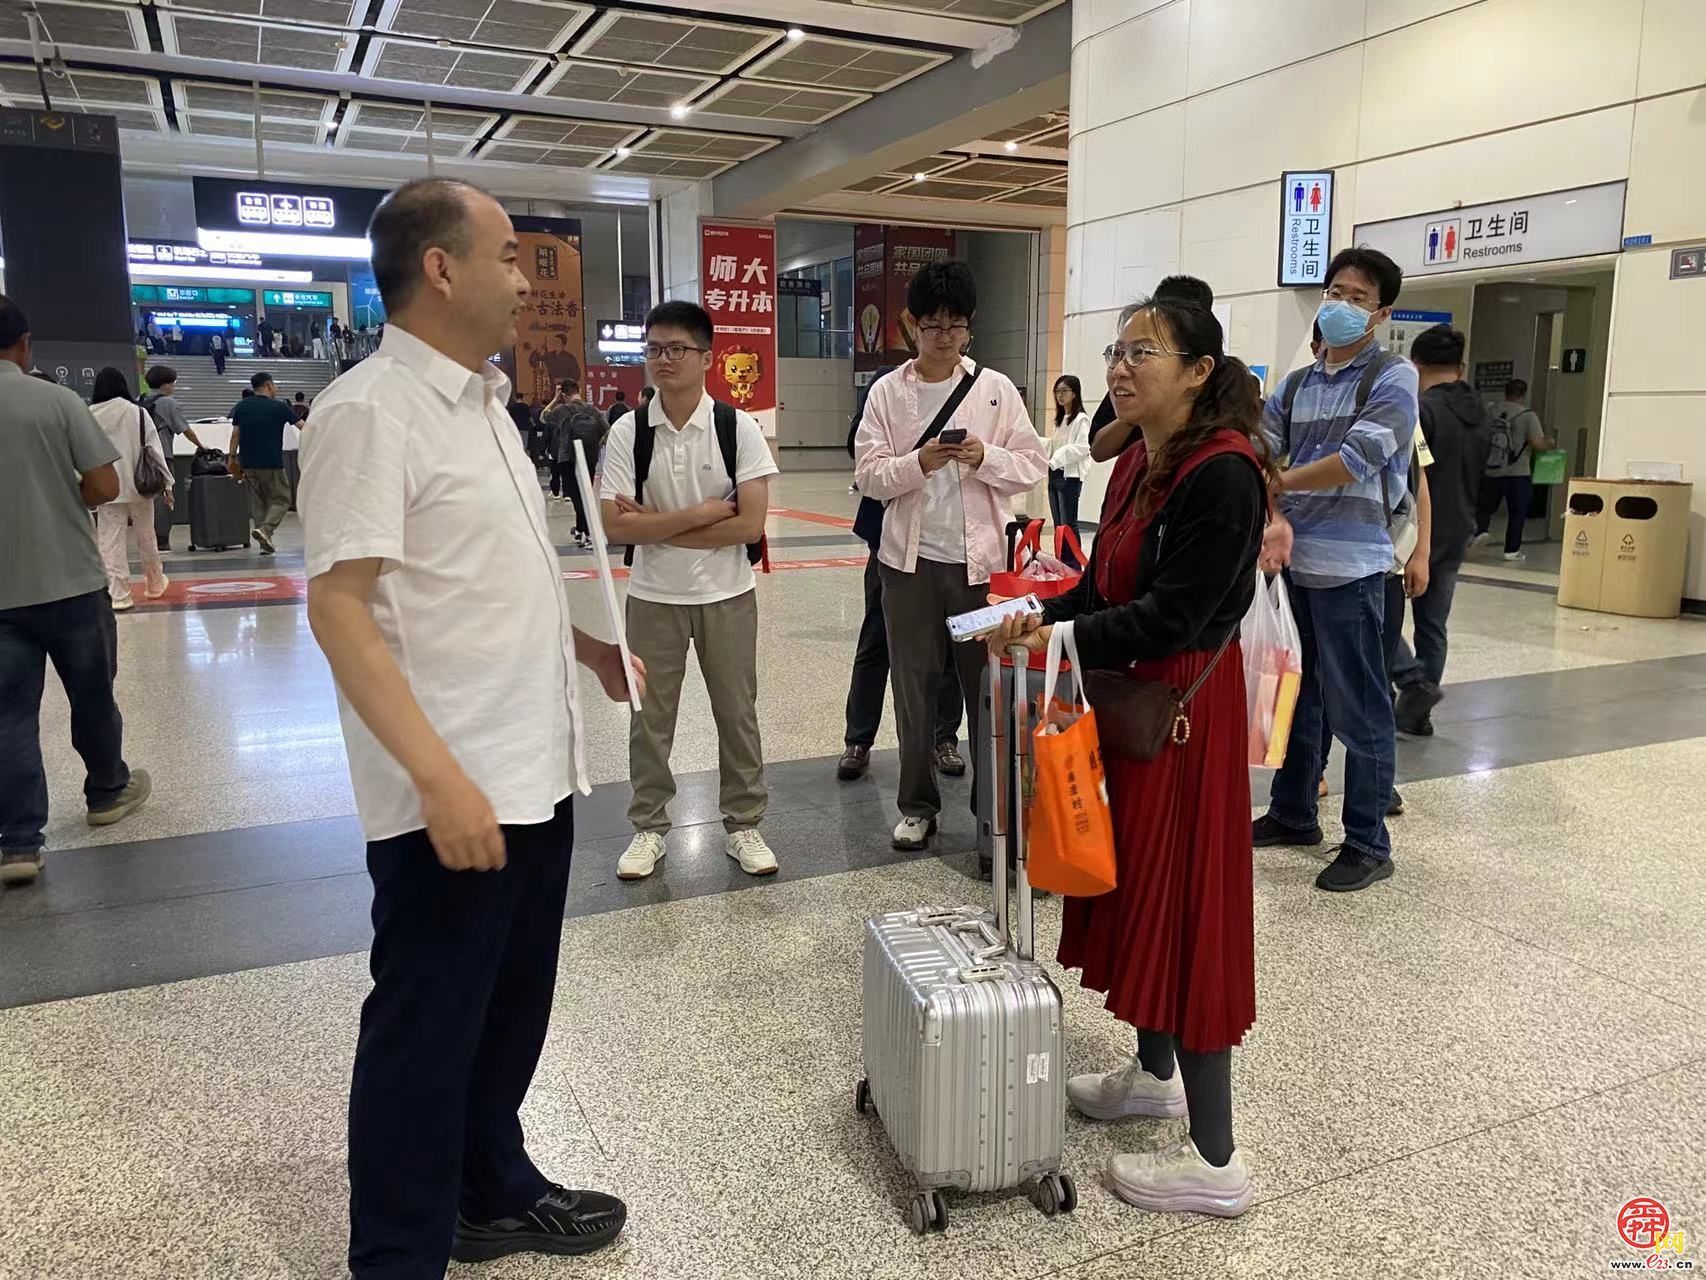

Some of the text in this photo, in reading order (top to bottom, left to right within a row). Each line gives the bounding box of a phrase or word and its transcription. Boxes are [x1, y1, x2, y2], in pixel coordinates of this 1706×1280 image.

[1463, 210, 1530, 241] 卫生间
[1289, 218, 1301, 275] Restrooms
[1301, 218, 1321, 279] 卫生间
[1462, 242, 1523, 261] Restrooms
[709, 254, 769, 285] 师大
[704, 288, 774, 313] 专升本
